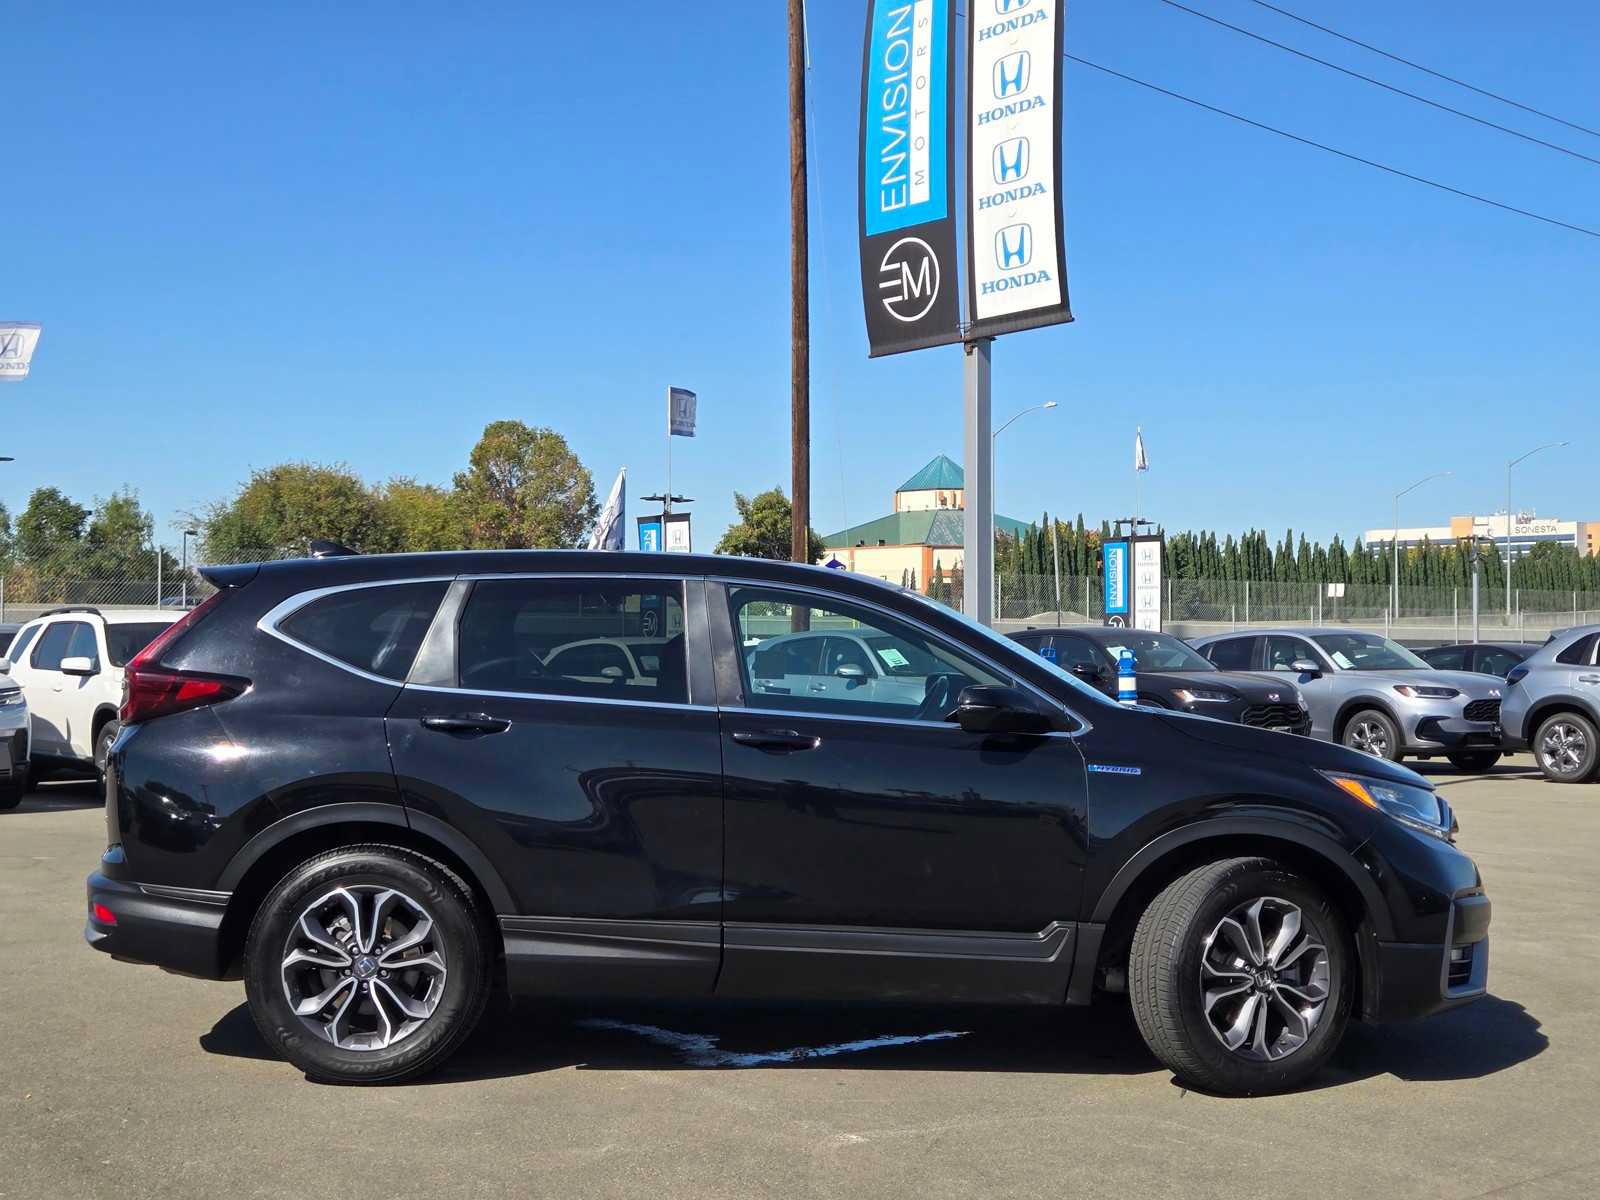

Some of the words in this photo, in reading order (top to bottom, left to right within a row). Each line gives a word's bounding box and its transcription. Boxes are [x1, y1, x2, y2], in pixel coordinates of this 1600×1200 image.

[978, 8, 1049, 42] HONDA
[881, 4, 912, 212] ENVISION
[914, 17, 929, 186] MOTORS
[977, 95, 1047, 126] HONDA
[978, 182, 1047, 210] HONDA
[981, 270, 1052, 295] HONDA
[1514, 525, 1558, 534] SONESTA
[1109, 548, 1118, 608] ENVISION
